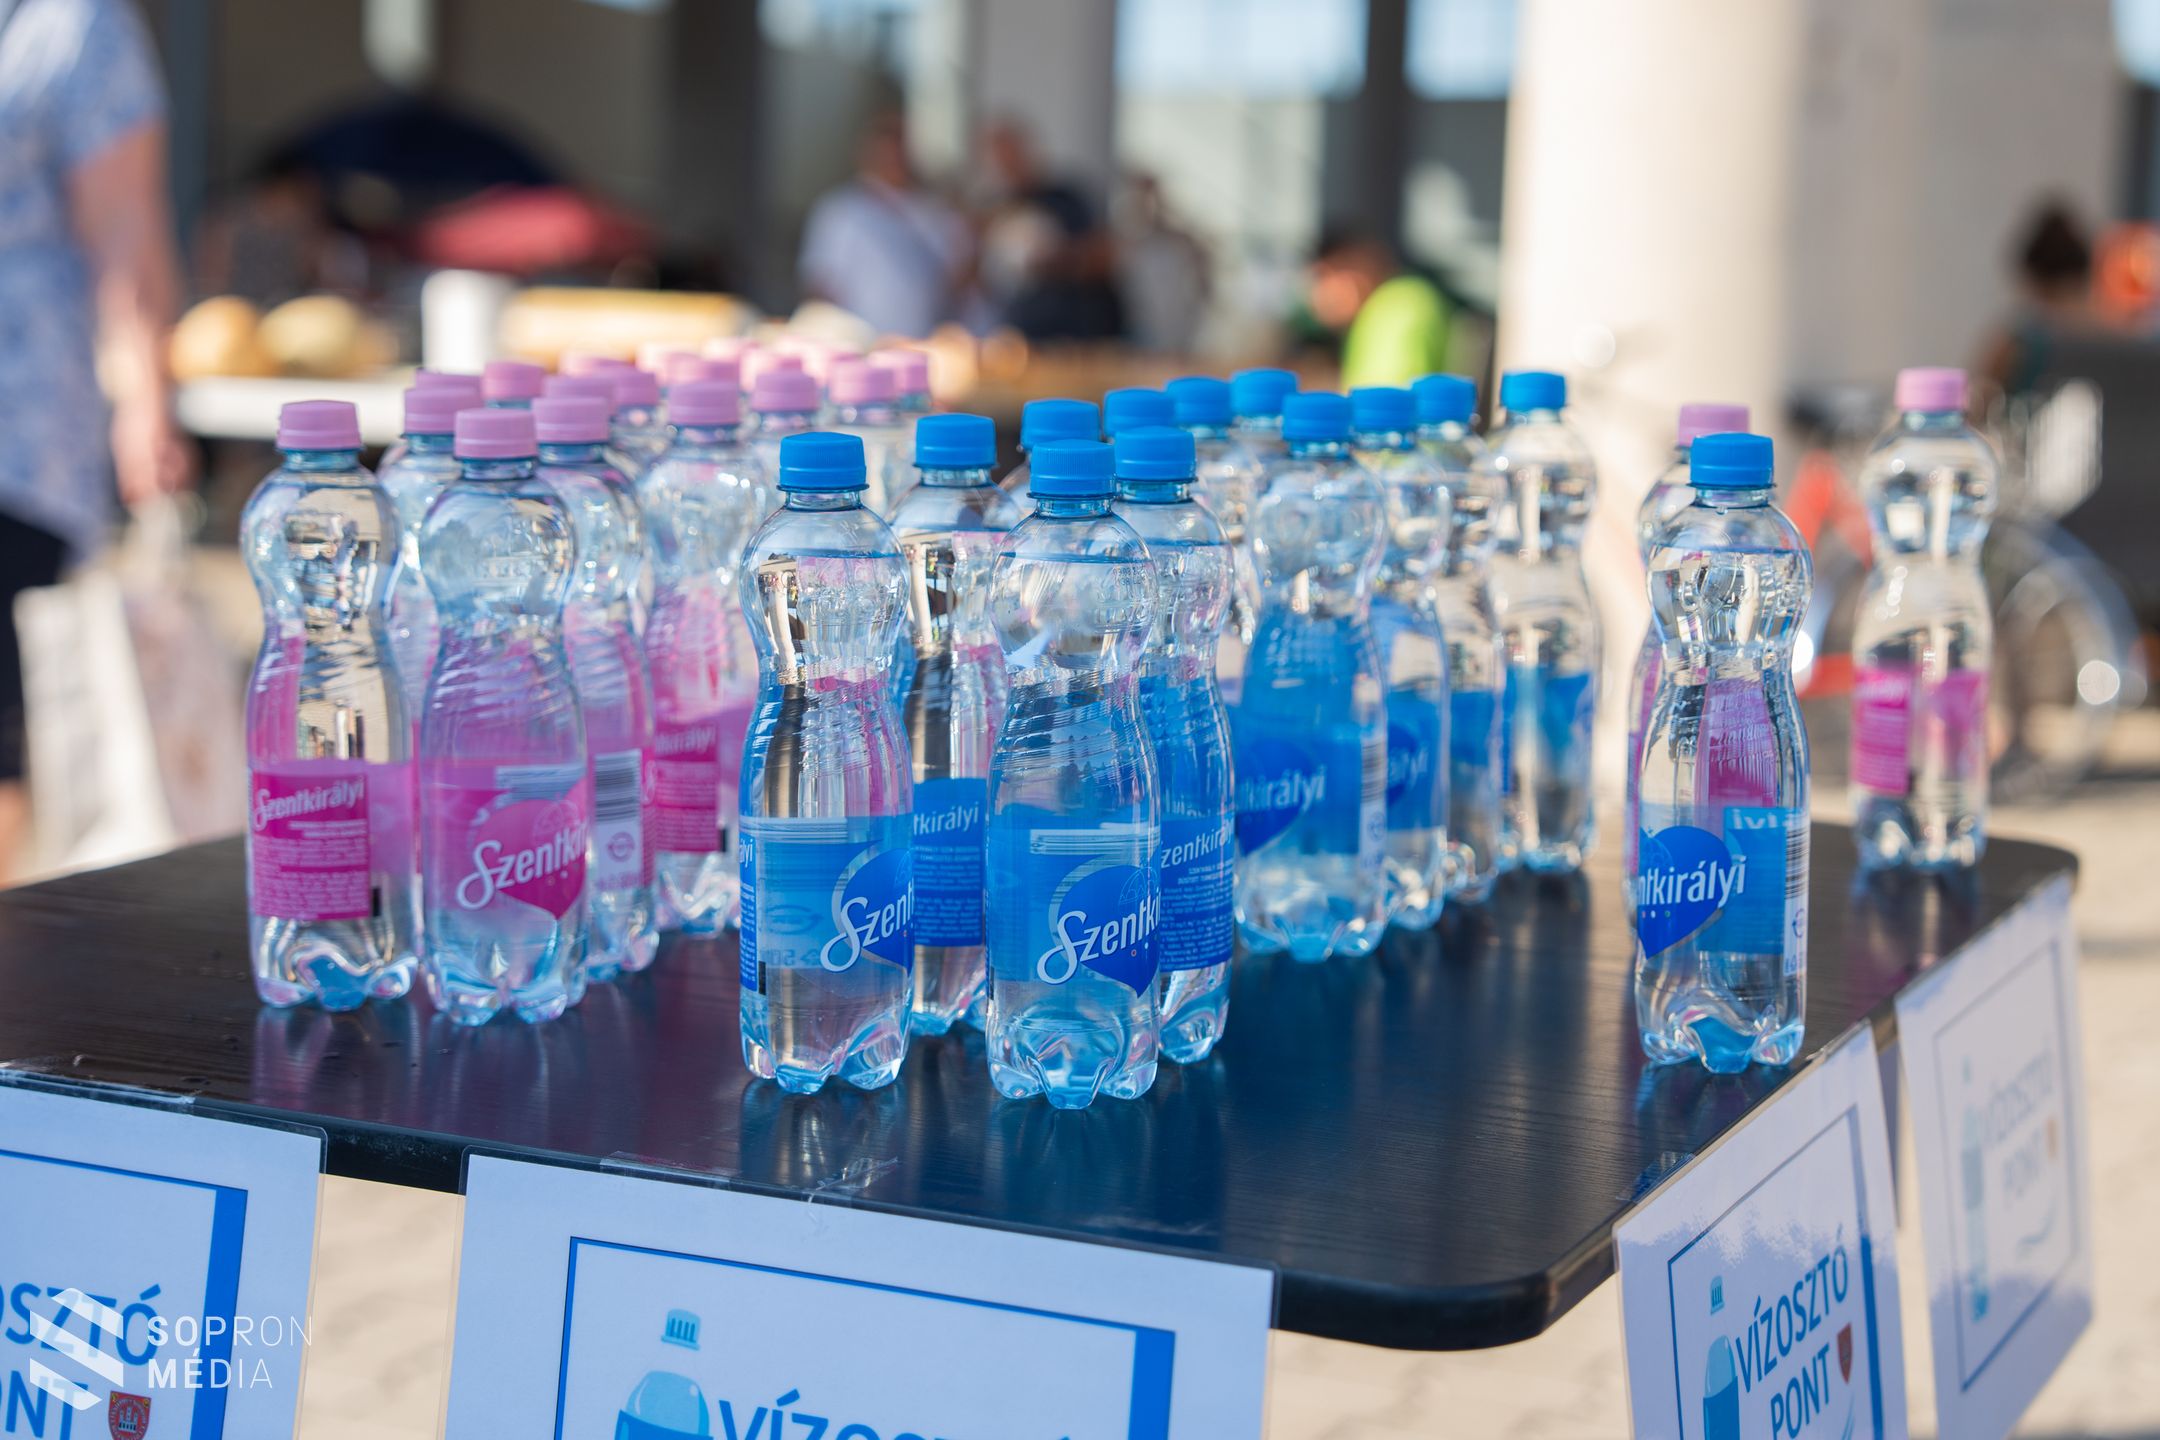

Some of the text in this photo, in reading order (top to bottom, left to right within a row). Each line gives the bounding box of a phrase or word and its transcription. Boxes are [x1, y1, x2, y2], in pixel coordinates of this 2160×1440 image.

[0, 1283, 161, 1367] SZTÓ
[1735, 1222, 1849, 1394] VÍZOSZTÓ
[1770, 1341, 1830, 1440] PONT
